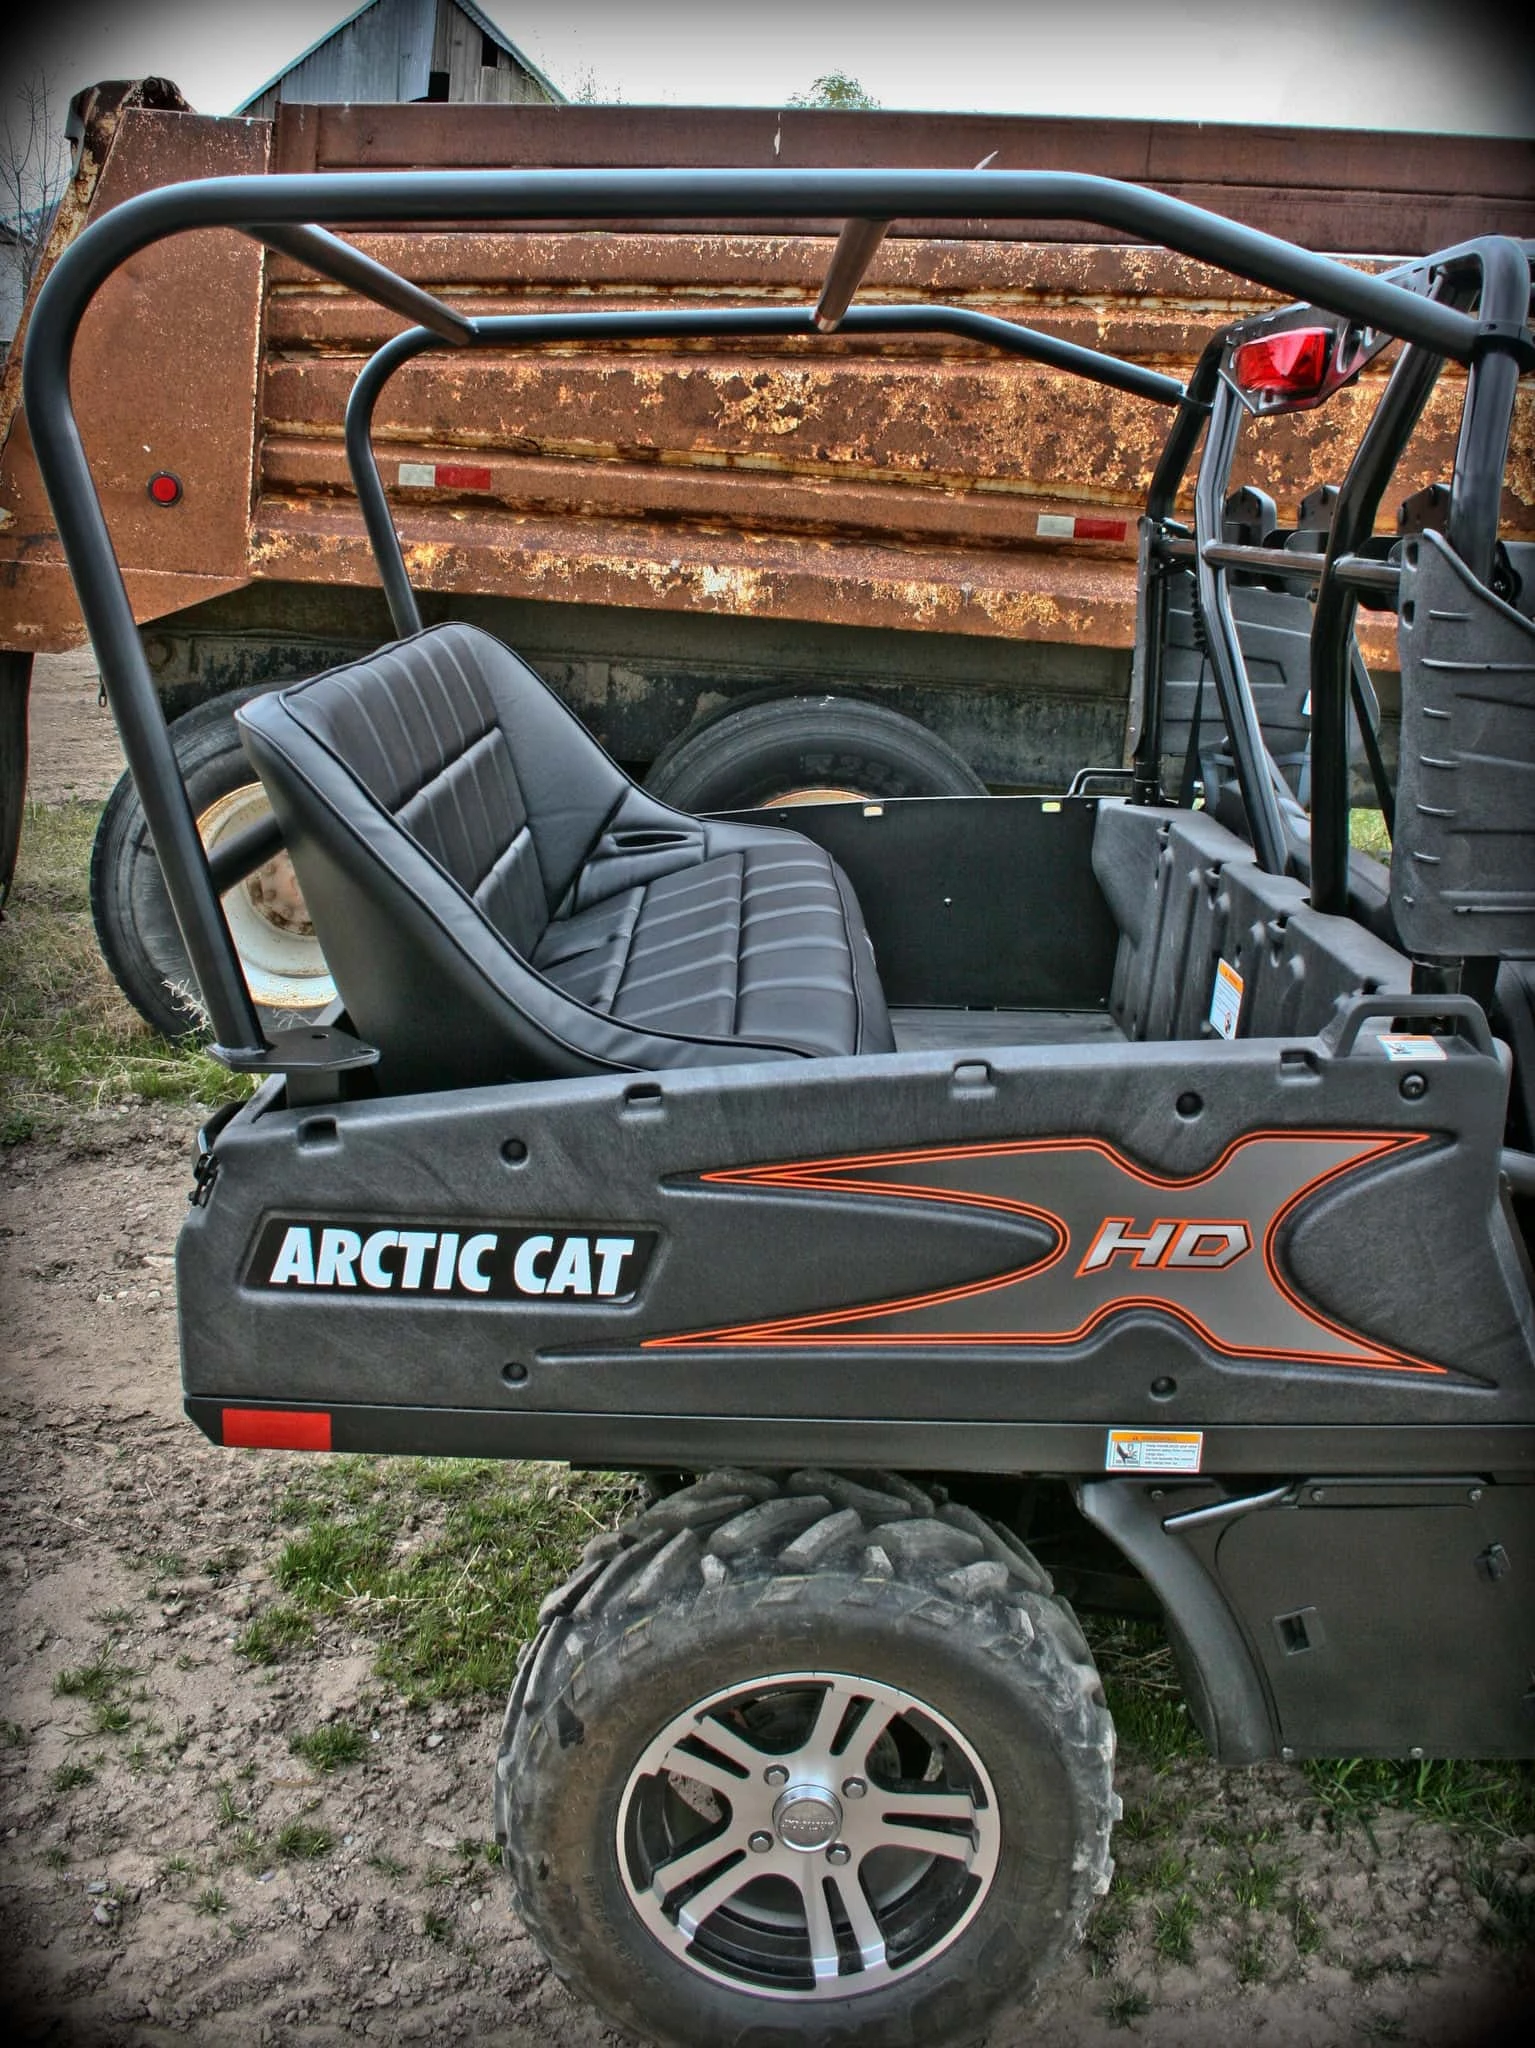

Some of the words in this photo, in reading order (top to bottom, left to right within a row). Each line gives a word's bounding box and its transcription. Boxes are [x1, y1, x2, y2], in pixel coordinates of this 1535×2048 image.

[270, 1227, 498, 1292] ARCTIC
[514, 1236, 634, 1295] CAT
[1075, 1217, 1254, 1278] HD
